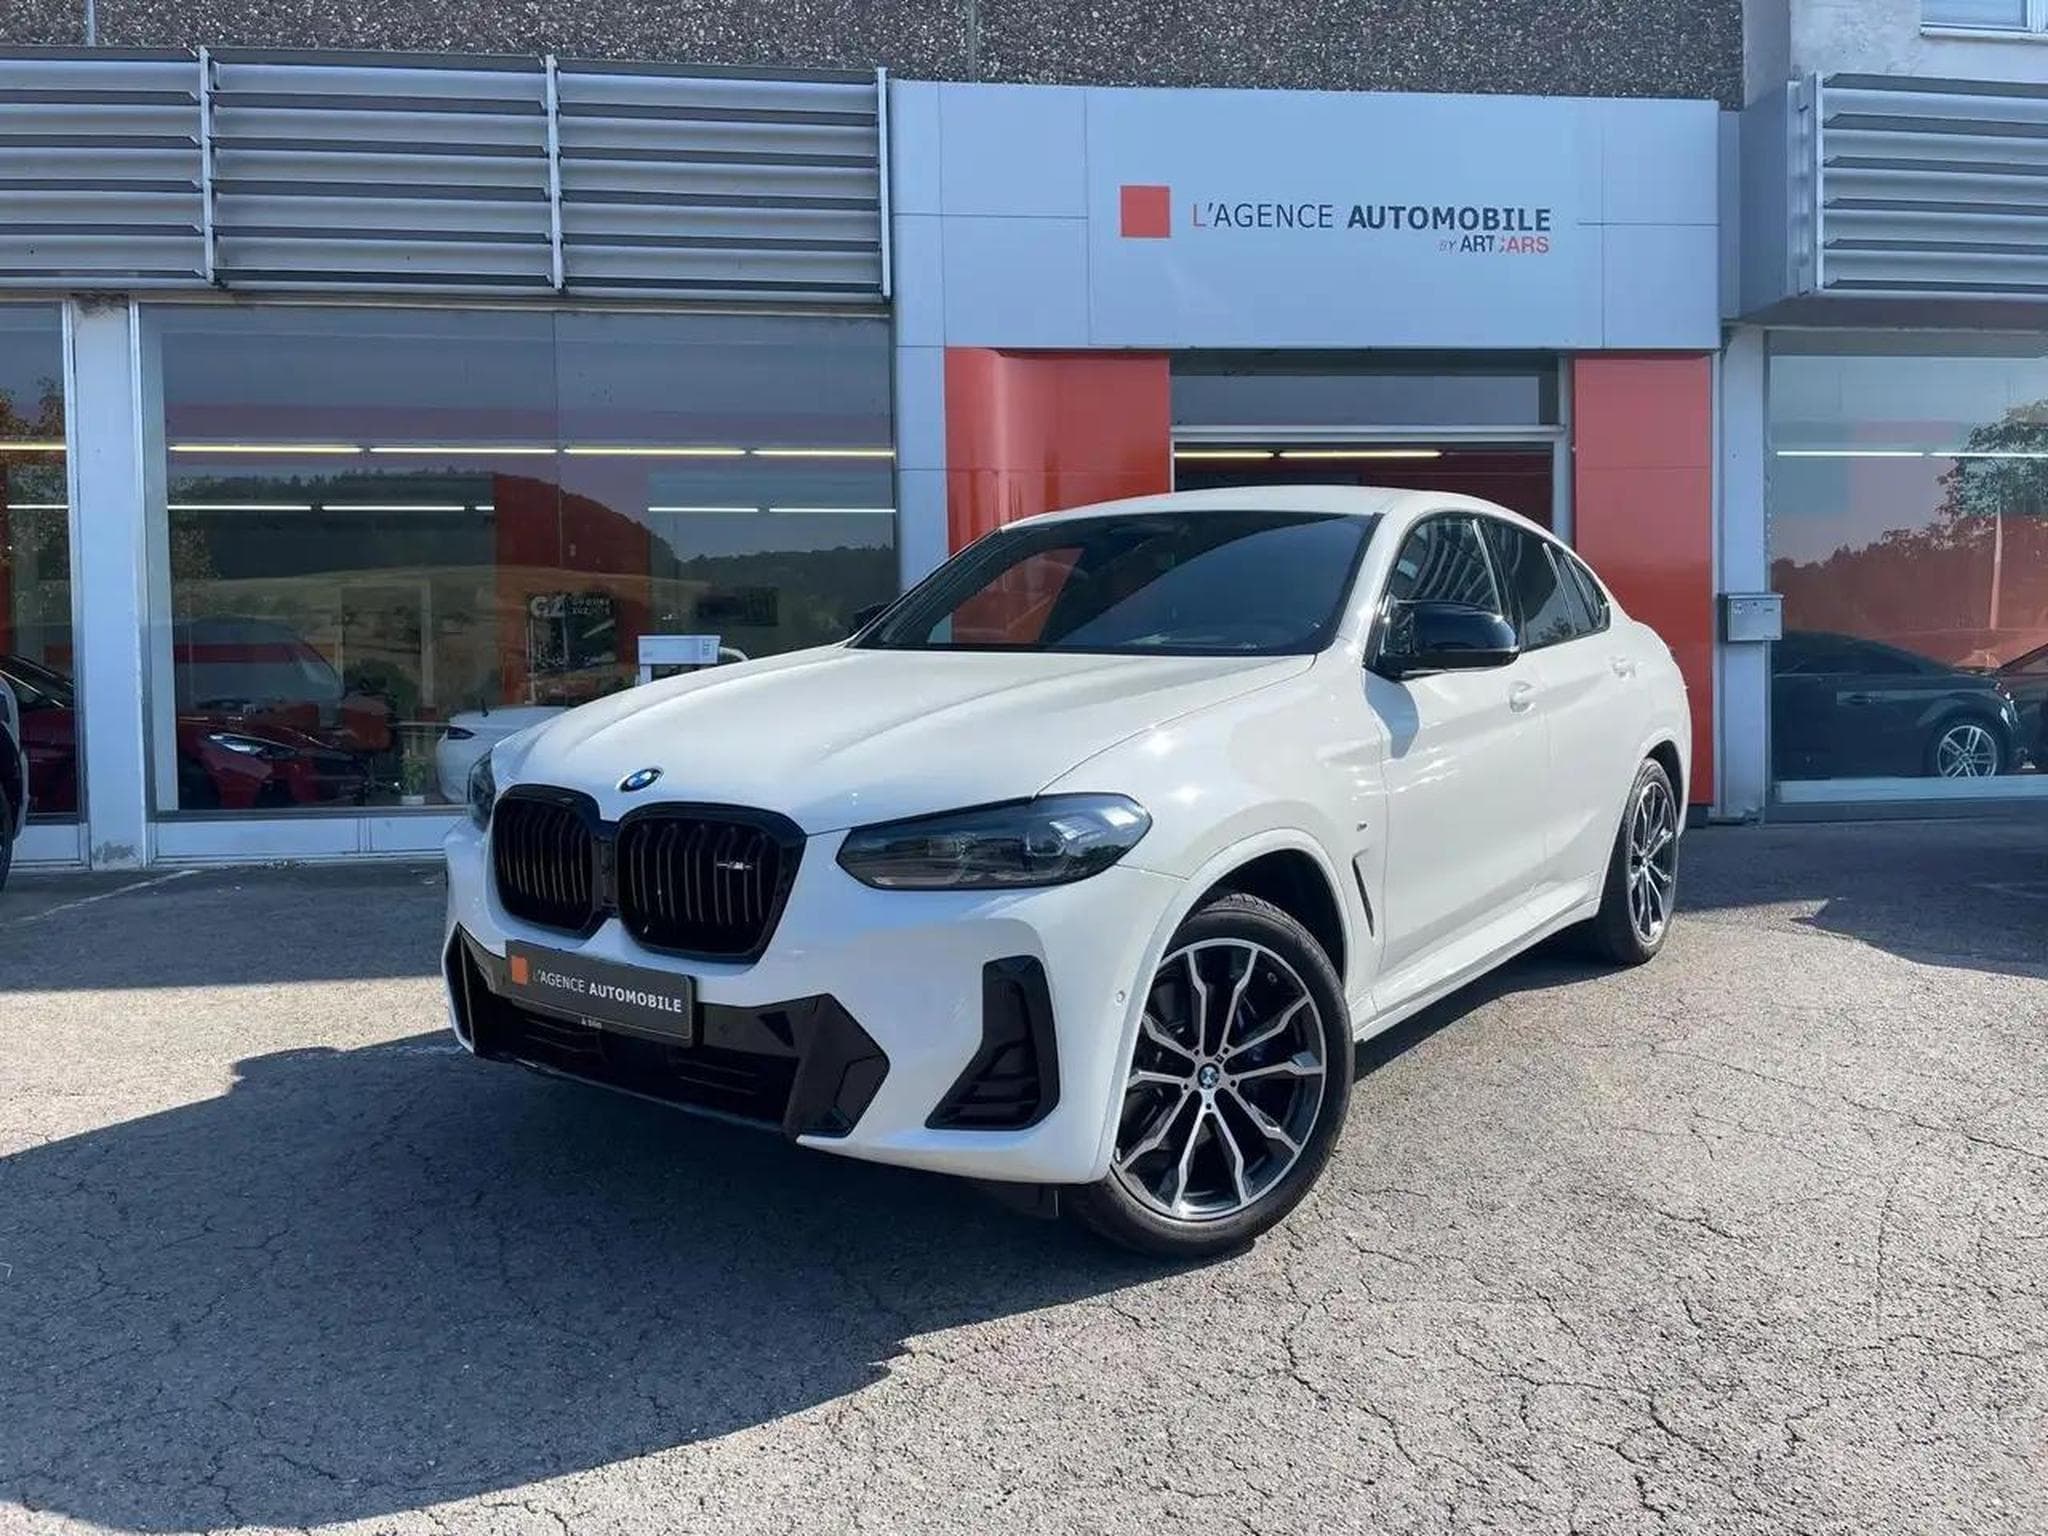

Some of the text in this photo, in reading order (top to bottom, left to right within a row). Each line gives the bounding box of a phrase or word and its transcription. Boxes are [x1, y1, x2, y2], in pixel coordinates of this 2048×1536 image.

[1192, 202, 1551, 232] L'AGENCE AUTOMOBILE
[532, 967, 682, 1013] L'AGENCE AUTOMOBILE
